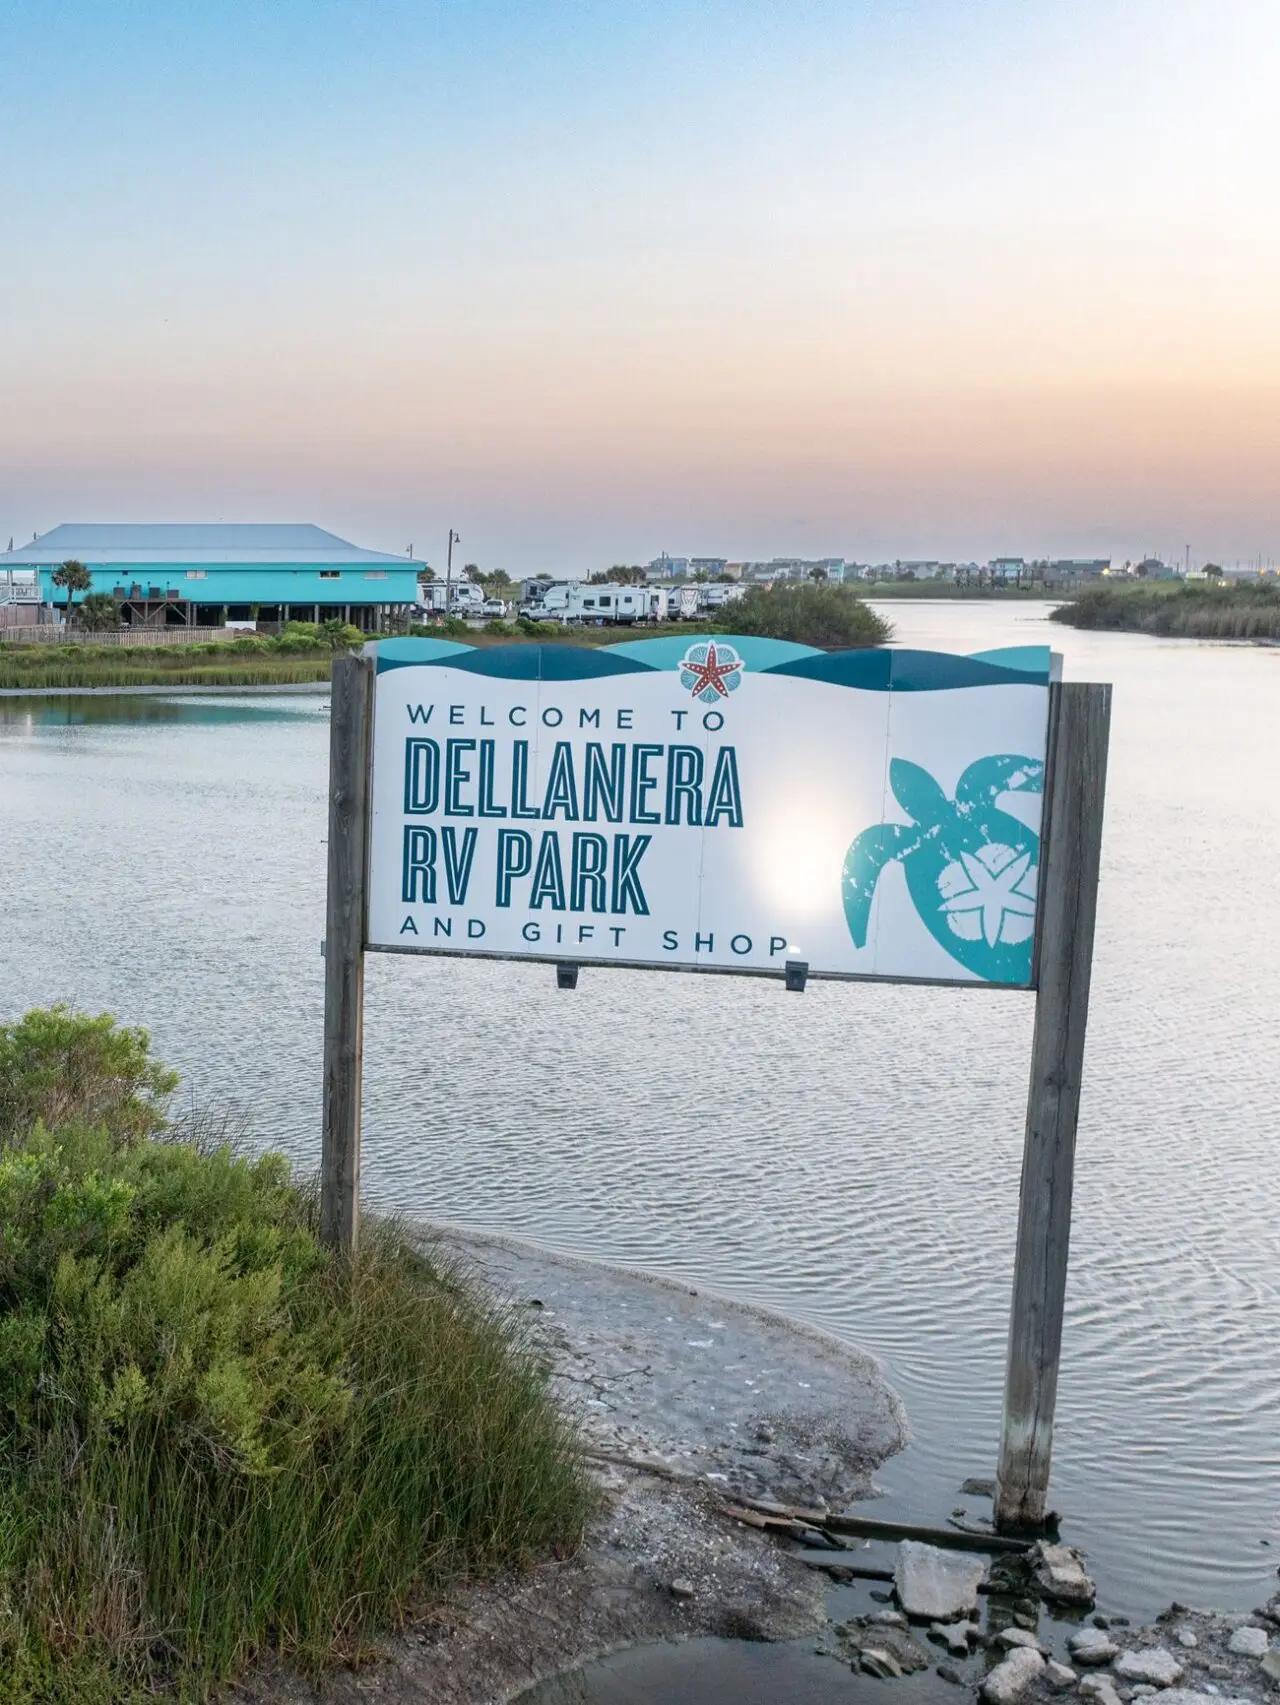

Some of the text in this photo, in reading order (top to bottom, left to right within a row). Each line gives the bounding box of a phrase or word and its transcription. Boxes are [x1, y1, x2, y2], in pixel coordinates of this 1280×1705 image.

[406, 703, 725, 732] WELCOME TO
[403, 736, 744, 828] DELLANERA
[401, 824, 653, 916] RV PARK
[399, 915, 788, 957] AND GIFT SHOP
